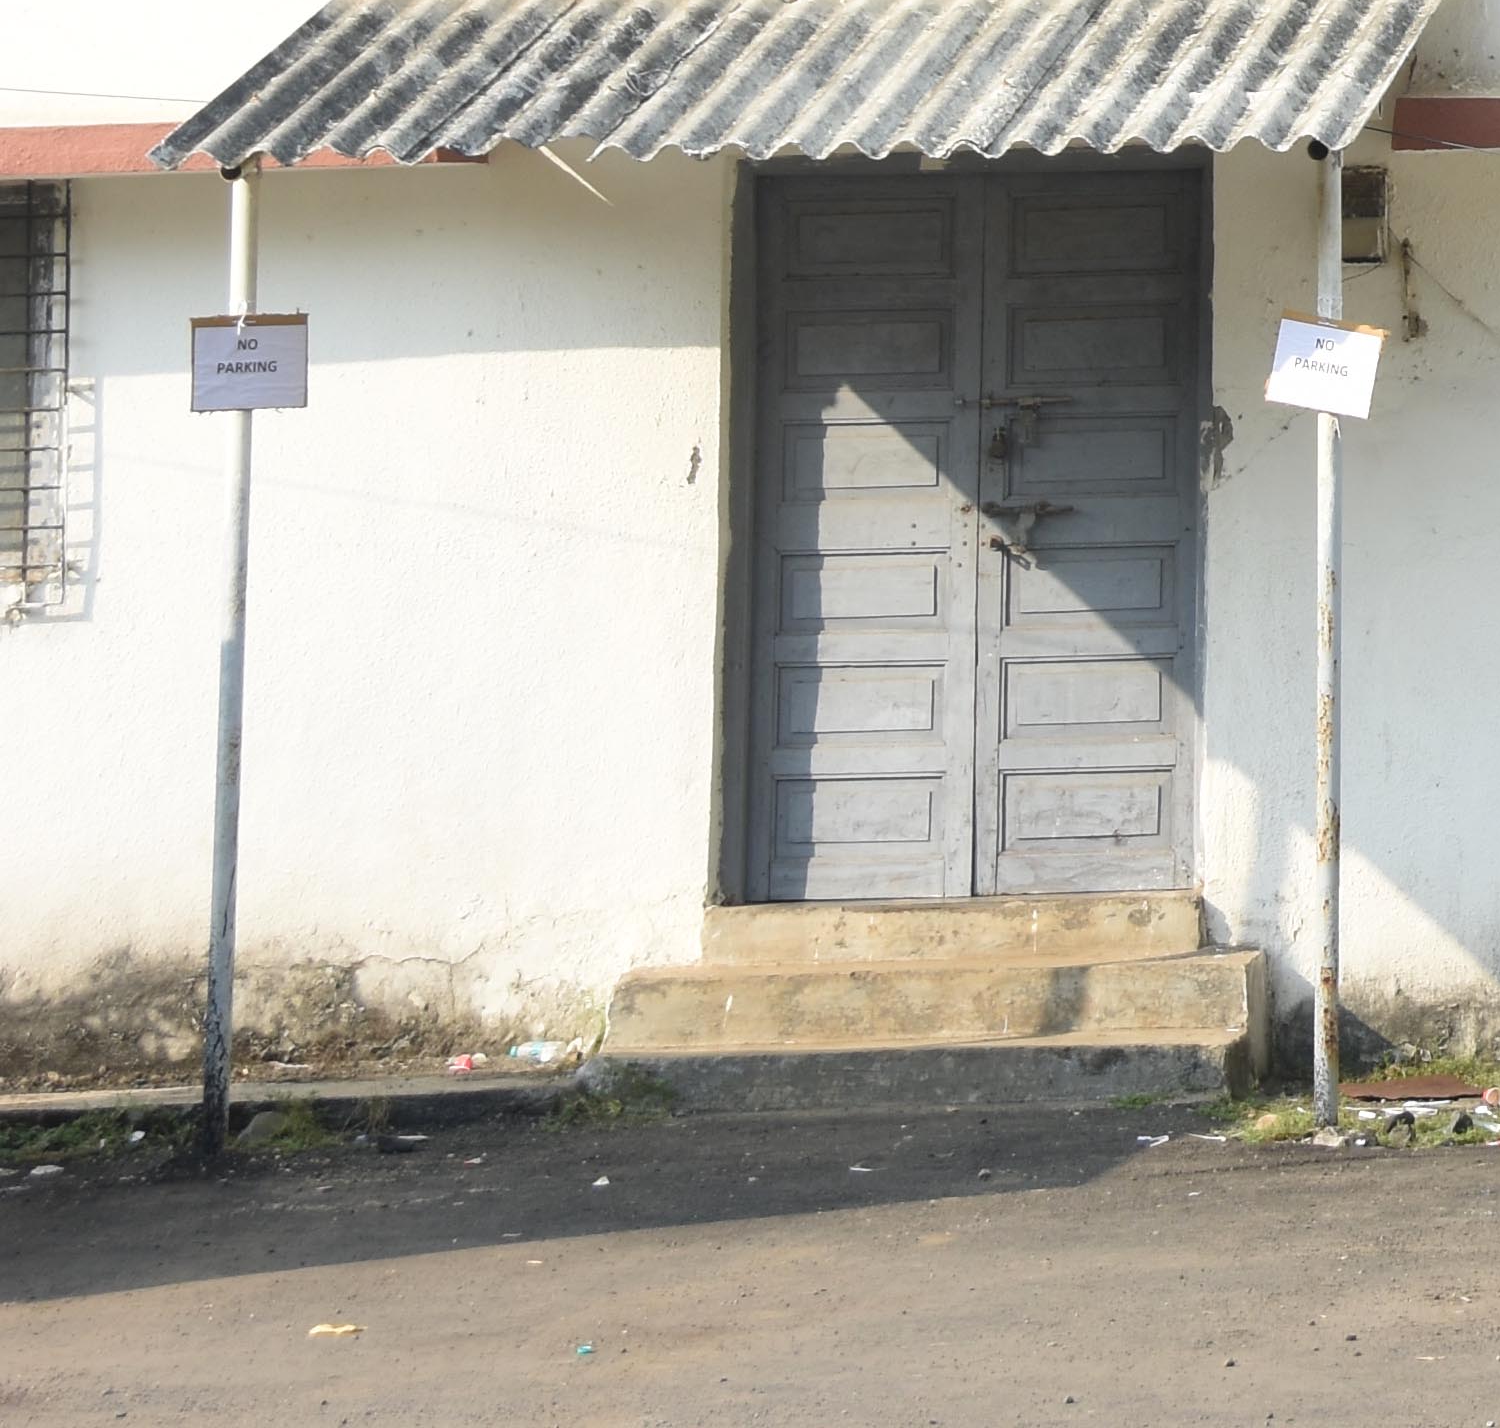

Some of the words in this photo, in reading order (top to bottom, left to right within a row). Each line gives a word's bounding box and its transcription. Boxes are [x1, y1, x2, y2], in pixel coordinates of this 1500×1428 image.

[237, 339, 258, 350] NO
[1315, 338, 1335, 351] NO
[216, 361, 278, 374] PARKING
[1294, 357, 1349, 377] PARKING
